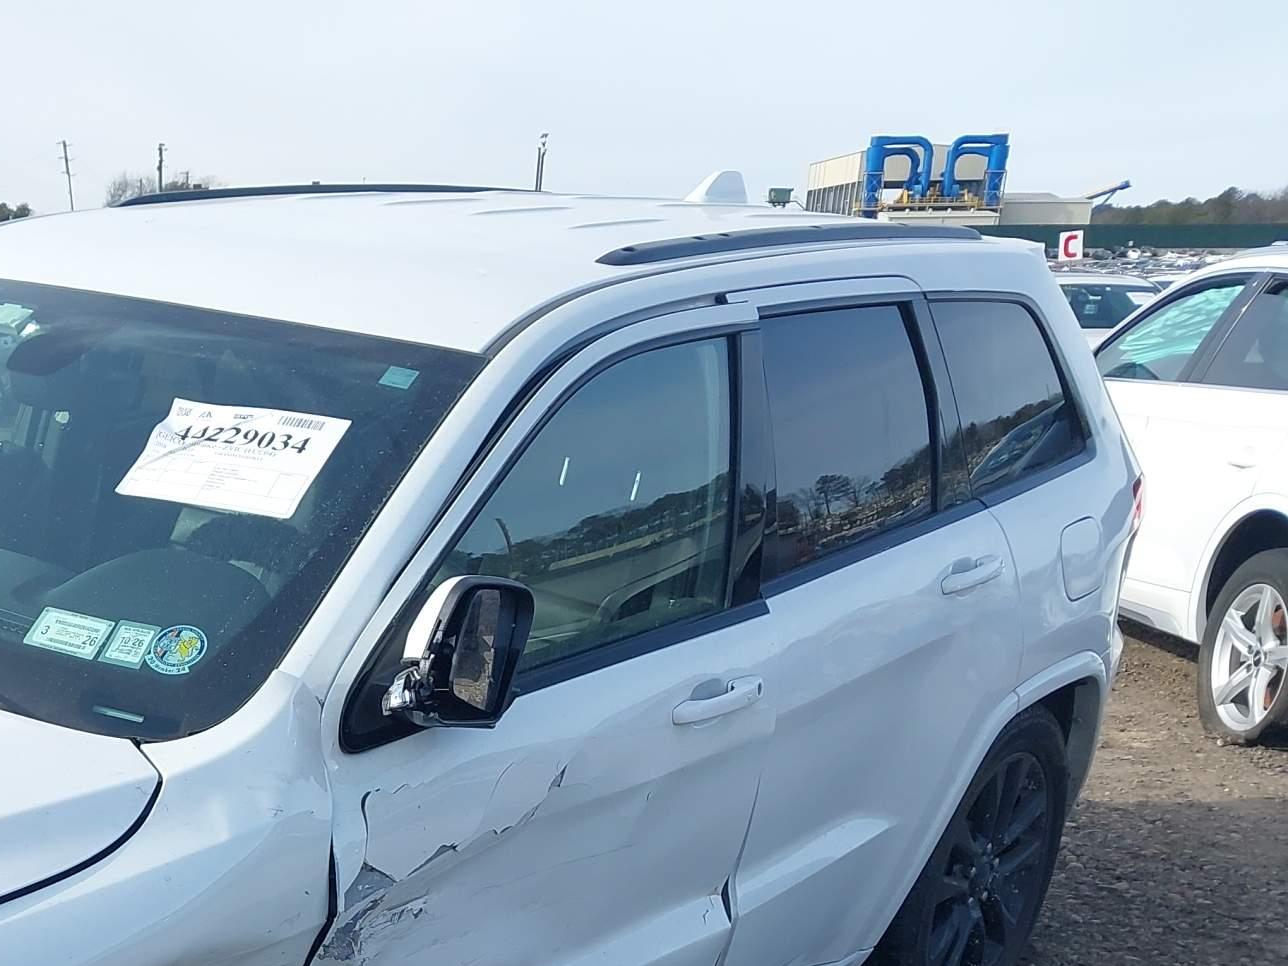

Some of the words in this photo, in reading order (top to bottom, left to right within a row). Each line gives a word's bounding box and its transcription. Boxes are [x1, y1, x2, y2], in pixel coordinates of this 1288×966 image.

[1064, 234, 1078, 258] C
[175, 425, 311, 454] 44229034
[41, 625, 51, 635] 3
[81, 635, 99, 647] 26
[132, 638, 145, 648] 26
